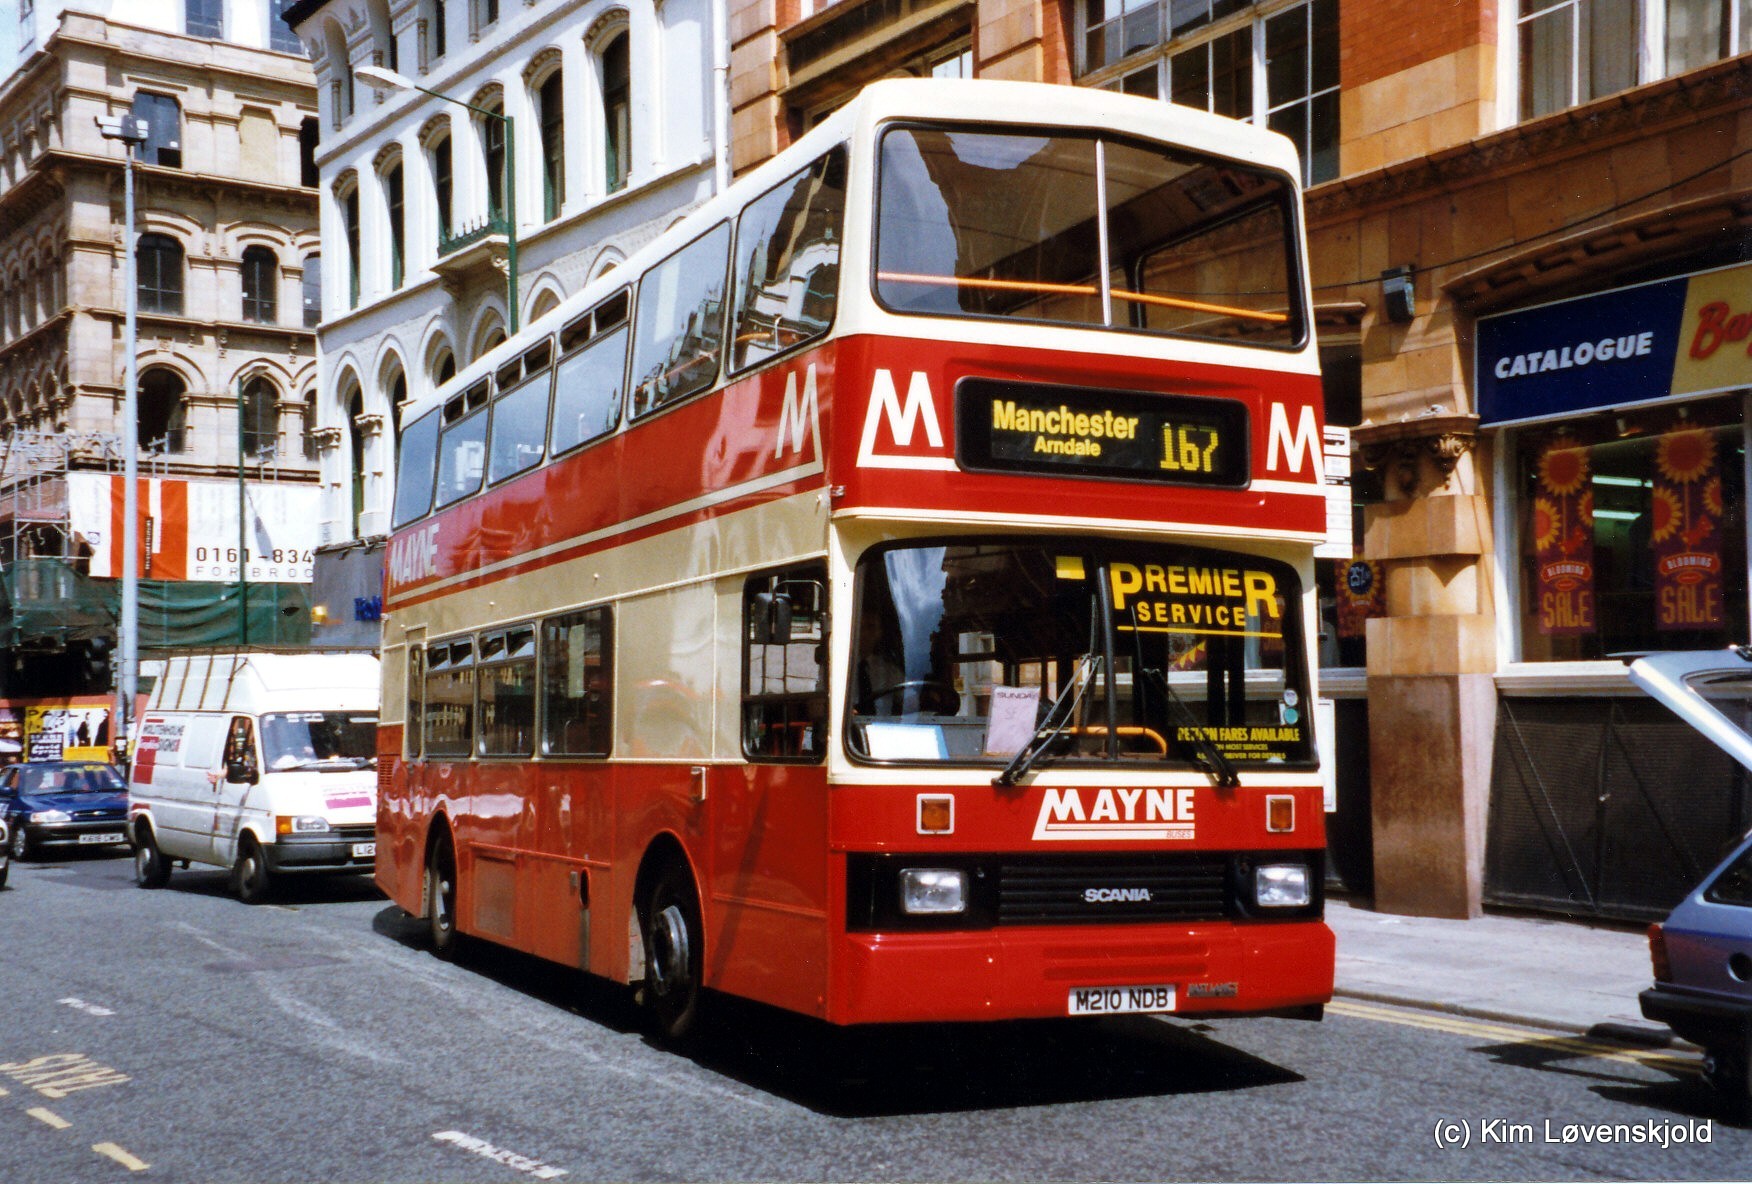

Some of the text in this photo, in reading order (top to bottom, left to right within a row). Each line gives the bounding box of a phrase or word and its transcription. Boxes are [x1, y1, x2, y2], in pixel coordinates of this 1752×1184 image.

[1494, 331, 1654, 379] CATALOGUE
[993, 399, 1219, 473] Manchester 167
[1033, 435, 1102, 457] Arndale
[196, 547, 312, 563] 0161-834
[387, 522, 440, 592] MAYNE
[1110, 562, 1279, 618] PREMIER
[1661, 584, 1718, 624] SALE
[1137, 601, 1246, 627] SERVICE
[1543, 591, 1592, 628] SALE
[1219, 727, 1249, 741] FARES
[1250, 727, 1300, 741] AVAILABLE
[1036, 788, 1195, 828] MAYNE
[1166, 830, 1192, 839] BUSES
[1084, 888, 1151, 902] SCANIA
[1076, 990, 1122, 1011] M210
[1128, 987, 1169, 1009] NDB
